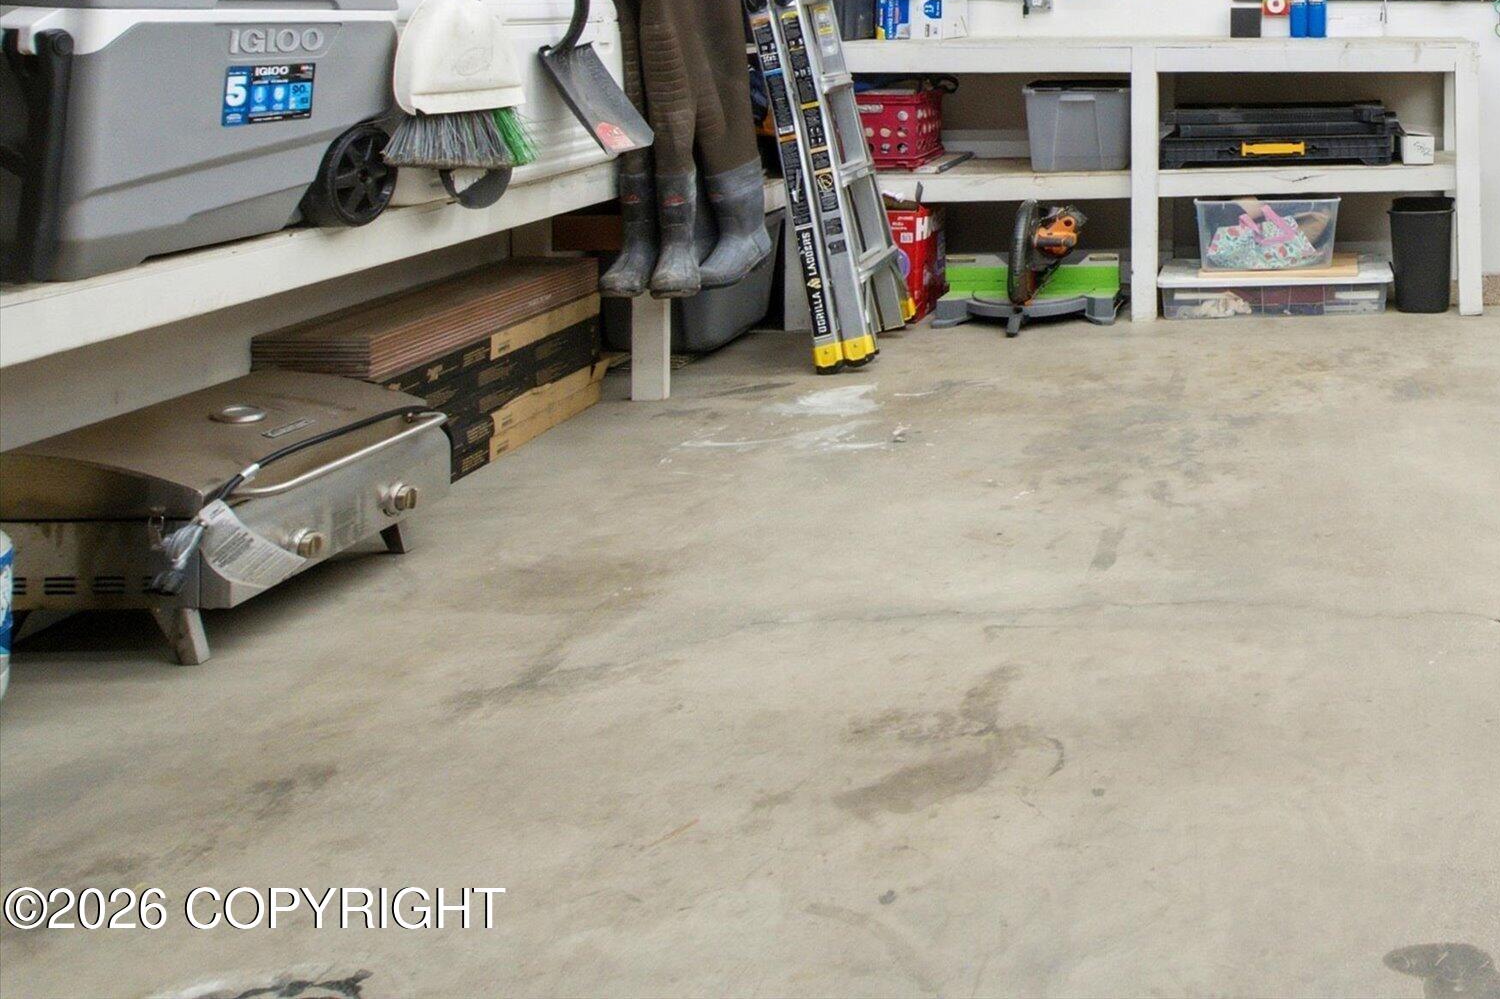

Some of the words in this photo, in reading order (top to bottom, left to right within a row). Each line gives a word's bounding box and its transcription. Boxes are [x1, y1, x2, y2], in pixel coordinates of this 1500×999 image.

[229, 27, 324, 55] IGLOO
[254, 66, 290, 76] IGLOO
[225, 75, 247, 107] 5
[801, 231, 818, 277] LADDERS
